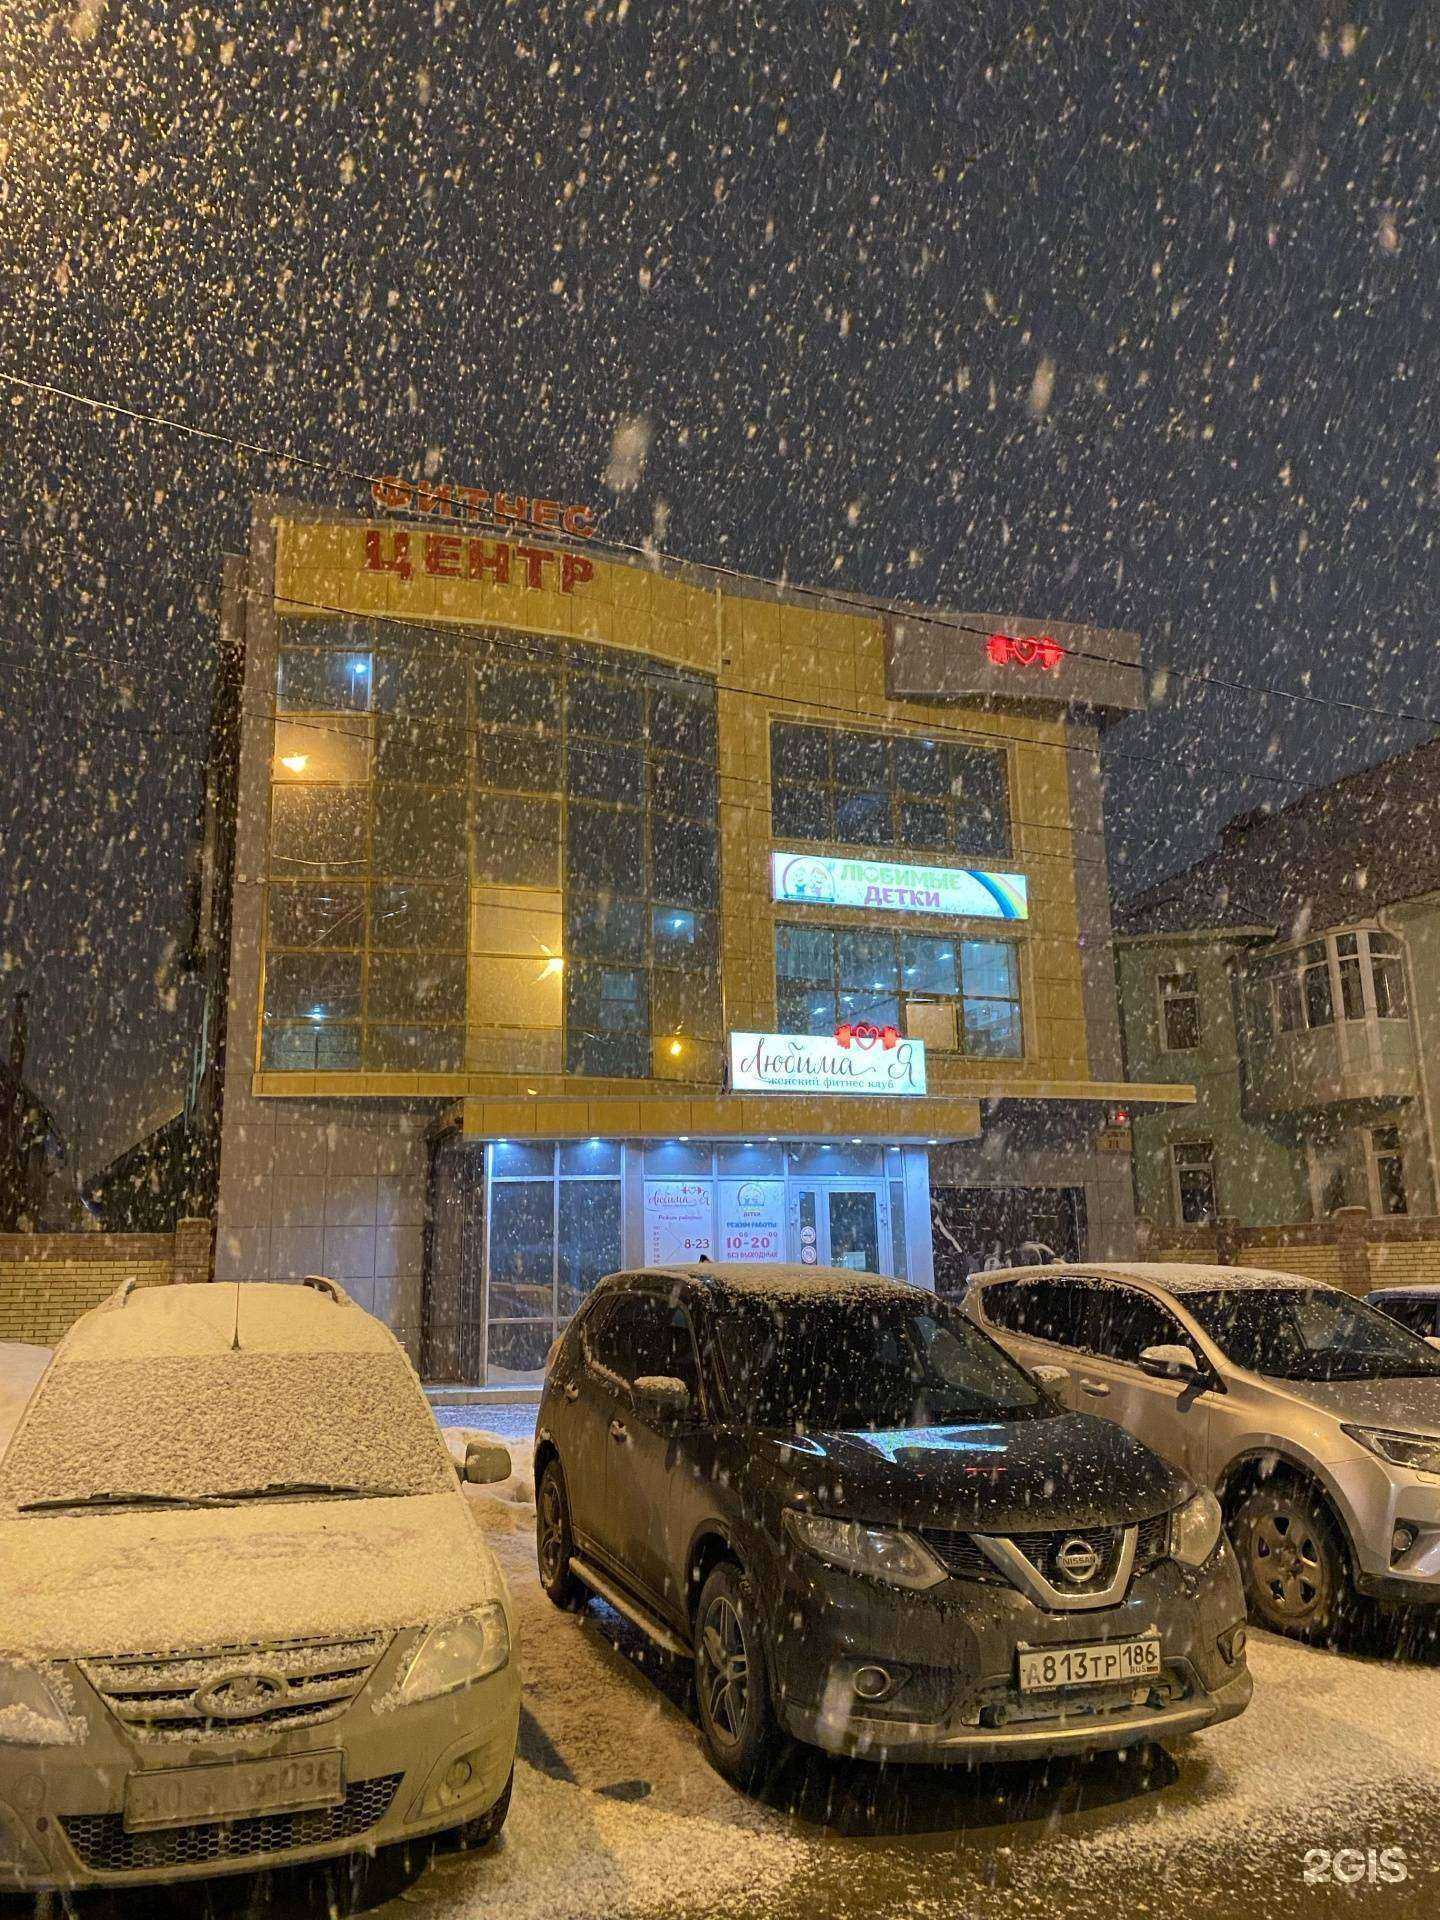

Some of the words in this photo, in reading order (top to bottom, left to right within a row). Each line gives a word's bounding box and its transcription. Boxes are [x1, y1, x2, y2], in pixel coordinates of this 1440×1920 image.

[371, 476, 599, 538] ФИТНЕС
[365, 530, 595, 596] ЦЕНТР
[840, 864, 962, 890] ЛЮБИМЫЕ
[864, 885, 940, 908] ДЕТКИ
[740, 1037, 876, 1083] Любима
[768, 1077, 819, 1087] женский
[824, 1077, 864, 1089] фитнес
[868, 1078, 894, 1089] клуб
[1062, 1553, 1096, 1566] NISSAN
[1122, 1643, 1157, 1667] 186
[1129, 1664, 1147, 1674] RUS
